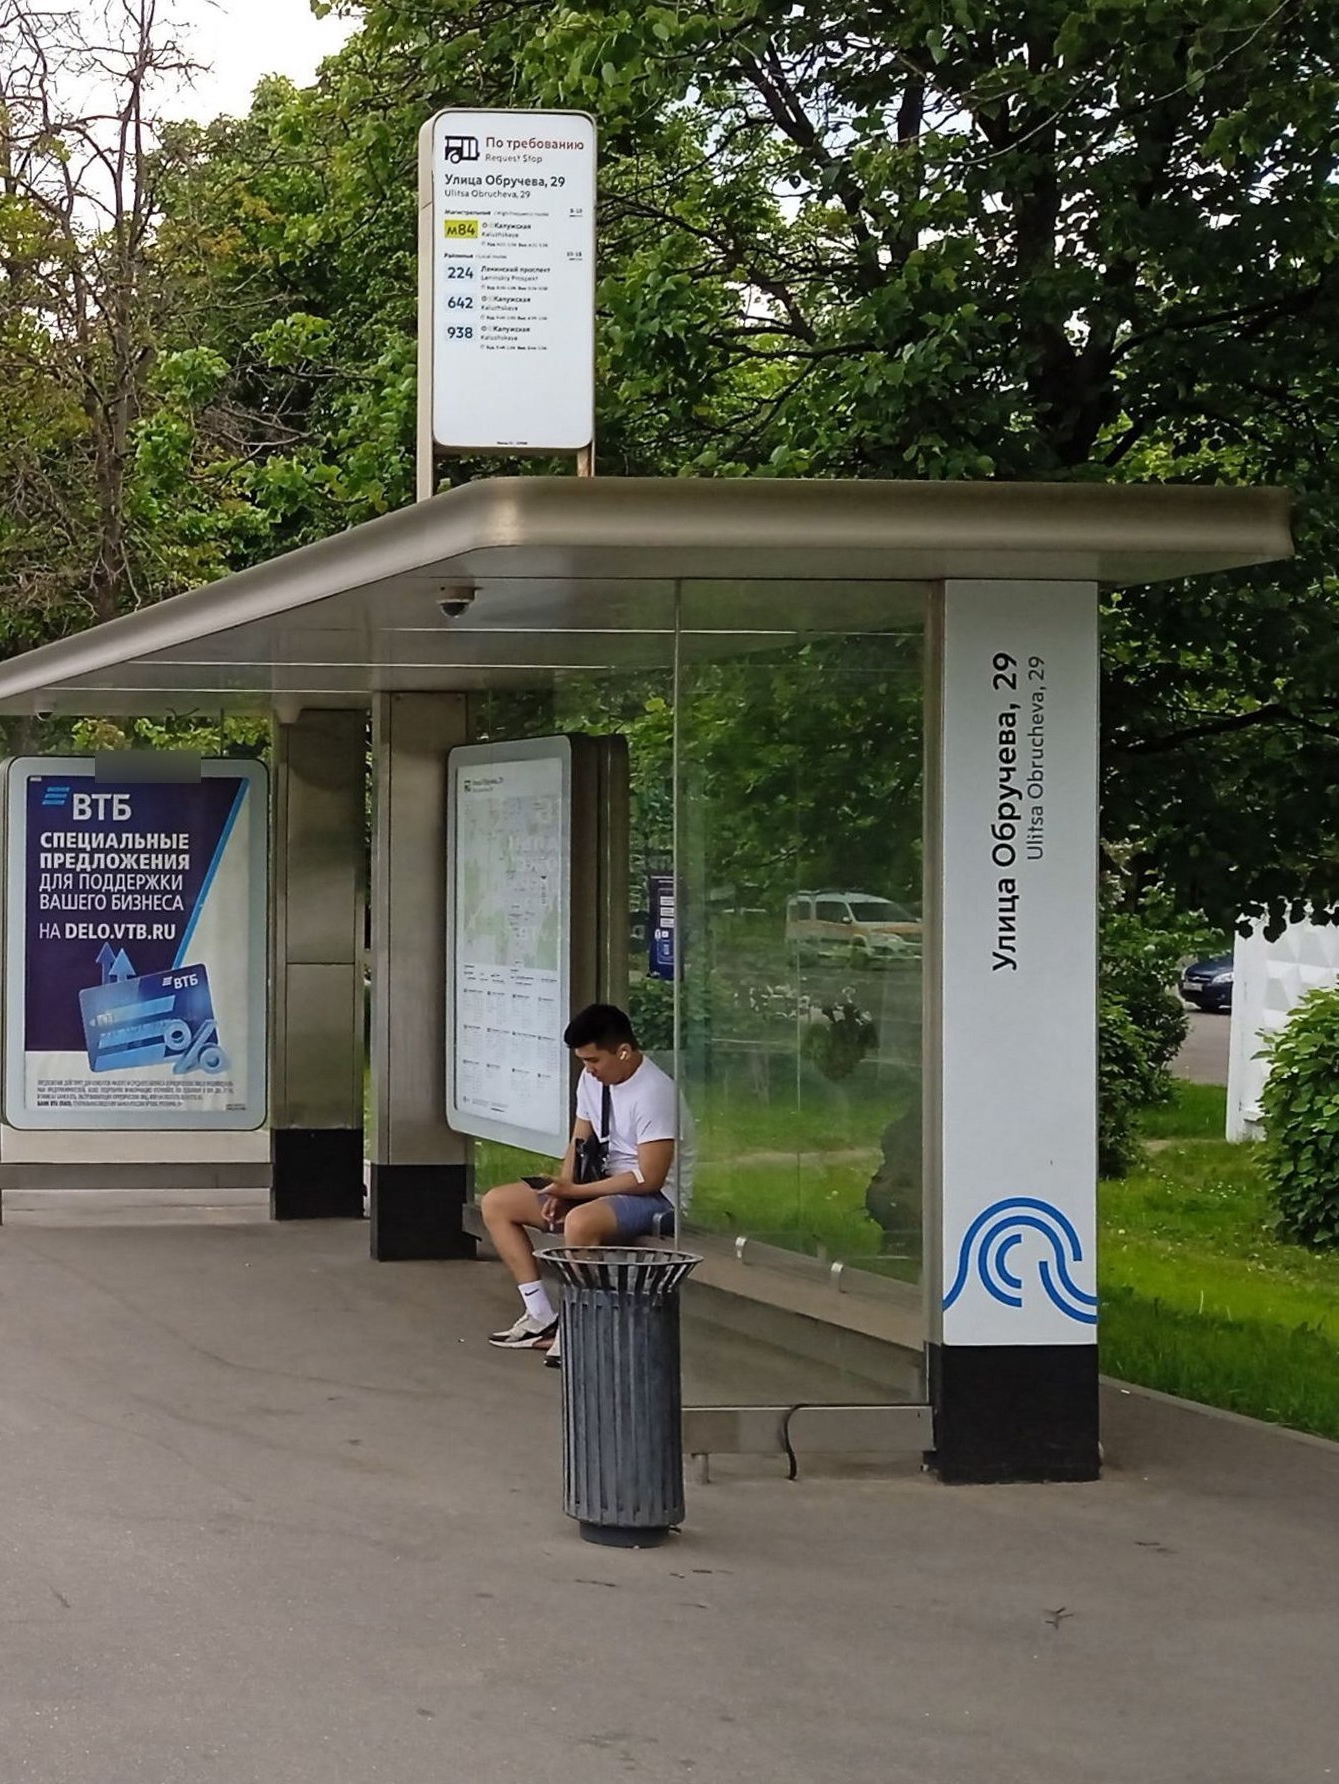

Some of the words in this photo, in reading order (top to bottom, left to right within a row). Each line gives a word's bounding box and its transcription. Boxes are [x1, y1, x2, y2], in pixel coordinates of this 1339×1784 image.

[486, 137, 505, 149] По
[507, 137, 584, 151] требованию
[485, 153, 520, 164] Request
[522, 154, 543, 164] Stop
[444, 174, 482, 187] Улица
[485, 174, 548, 188] Обручева,
[550, 176, 566, 188] 29
[444, 189, 470, 198] Ulitsa
[471, 189, 518, 199] Obrucheva,
[520, 191, 531, 199] 29
[447, 266, 474, 279] 224
[447, 296, 474, 309] 642
[447, 326, 474, 339] 938
[993, 652, 1019, 691] 29
[1028, 656, 1045, 682] 29
[1027, 686, 1046, 800] Obrucheva,
[991, 702, 1023, 868] Обручева,
[72, 793, 132, 821] ВТБ
[39, 831, 190, 852] СПЕЦИАЛЬНЫЕ
[1027, 808, 1045, 861] Ulitsa
[39, 852, 191, 873] ПРЕДЛОЖЕНИЯ
[39, 873, 73, 892] ДЛЯ
[78, 873, 184, 892] ПОДДЕРЖКИ
[39, 893, 107, 911] ВАШЕГО
[111, 894, 184, 912] БИЗНЕСА
[39, 923, 61, 939] НА
[65, 923, 176, 940] DELO.VTB.RU
[991, 878, 1021, 972] Улица
[173, 973, 199, 990] ВТБ
